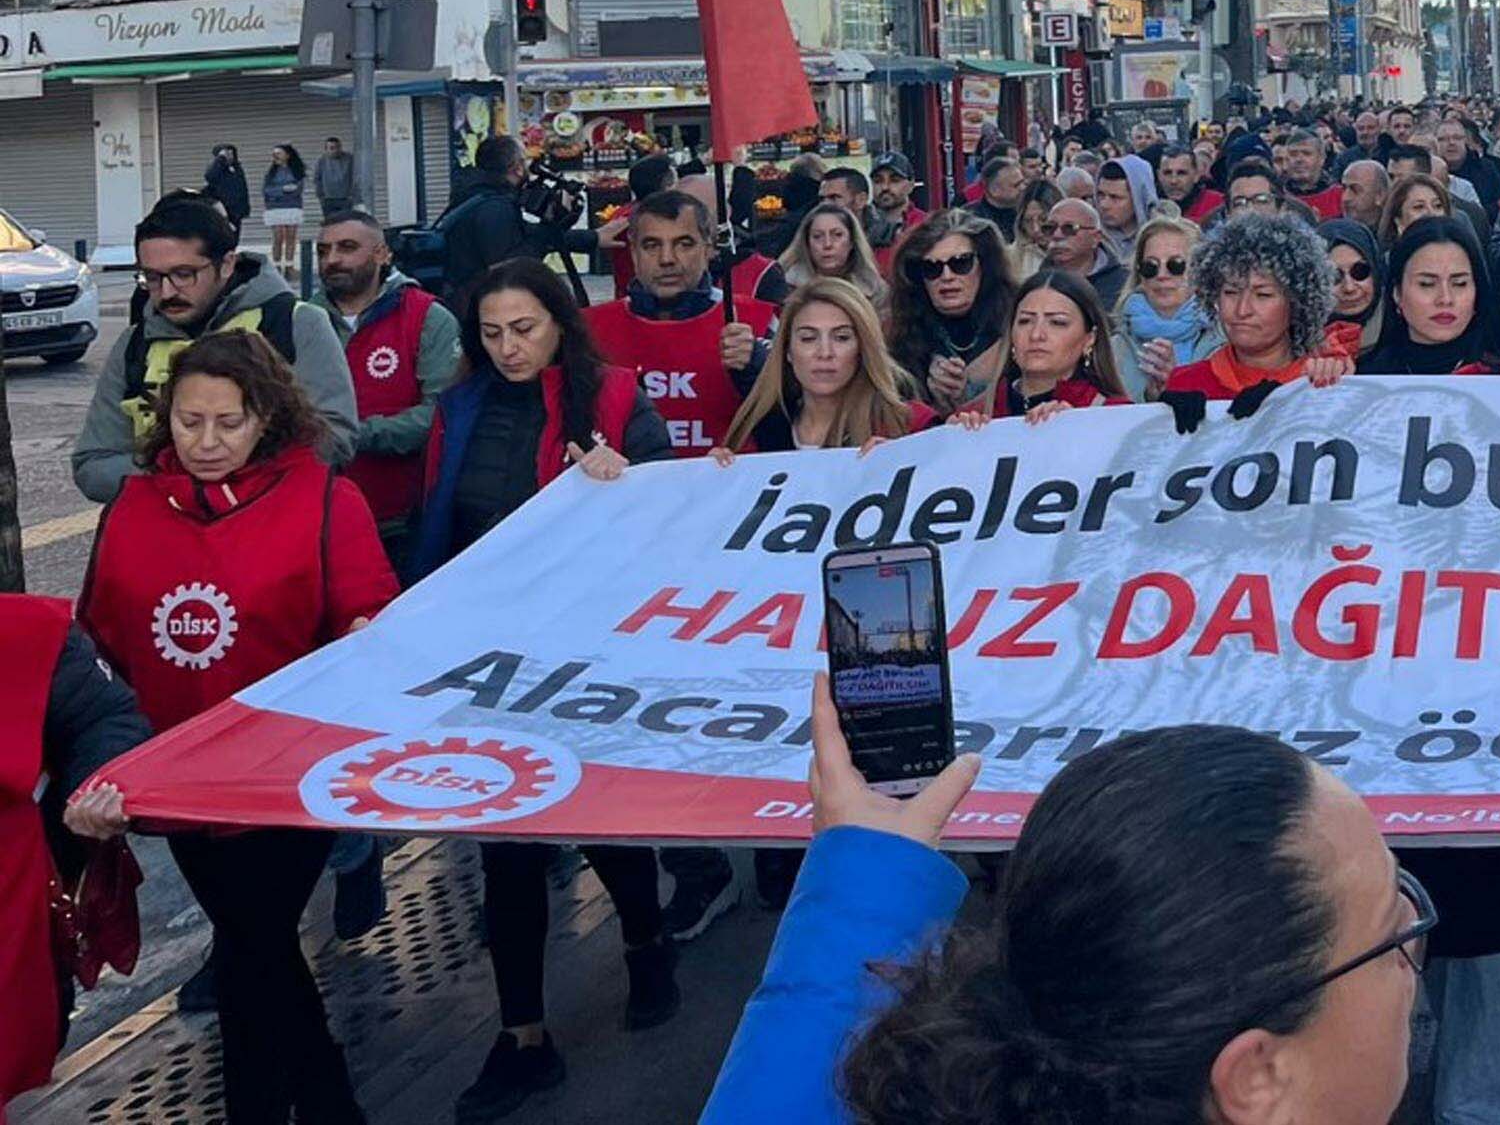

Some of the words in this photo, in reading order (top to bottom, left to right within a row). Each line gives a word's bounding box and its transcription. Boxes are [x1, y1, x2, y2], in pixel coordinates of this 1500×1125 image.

[95, 13, 180, 48] Vizyon
[190, 5, 265, 33] Moda
[1051, 19, 1066, 38] E
[637, 365, 697, 399] SK
[666, 420, 714, 448] EL
[722, 455, 1136, 554] iadeler
[1153, 439, 1360, 525] son
[169, 611, 218, 636] DİSK
[390, 766, 504, 795] DİSK
